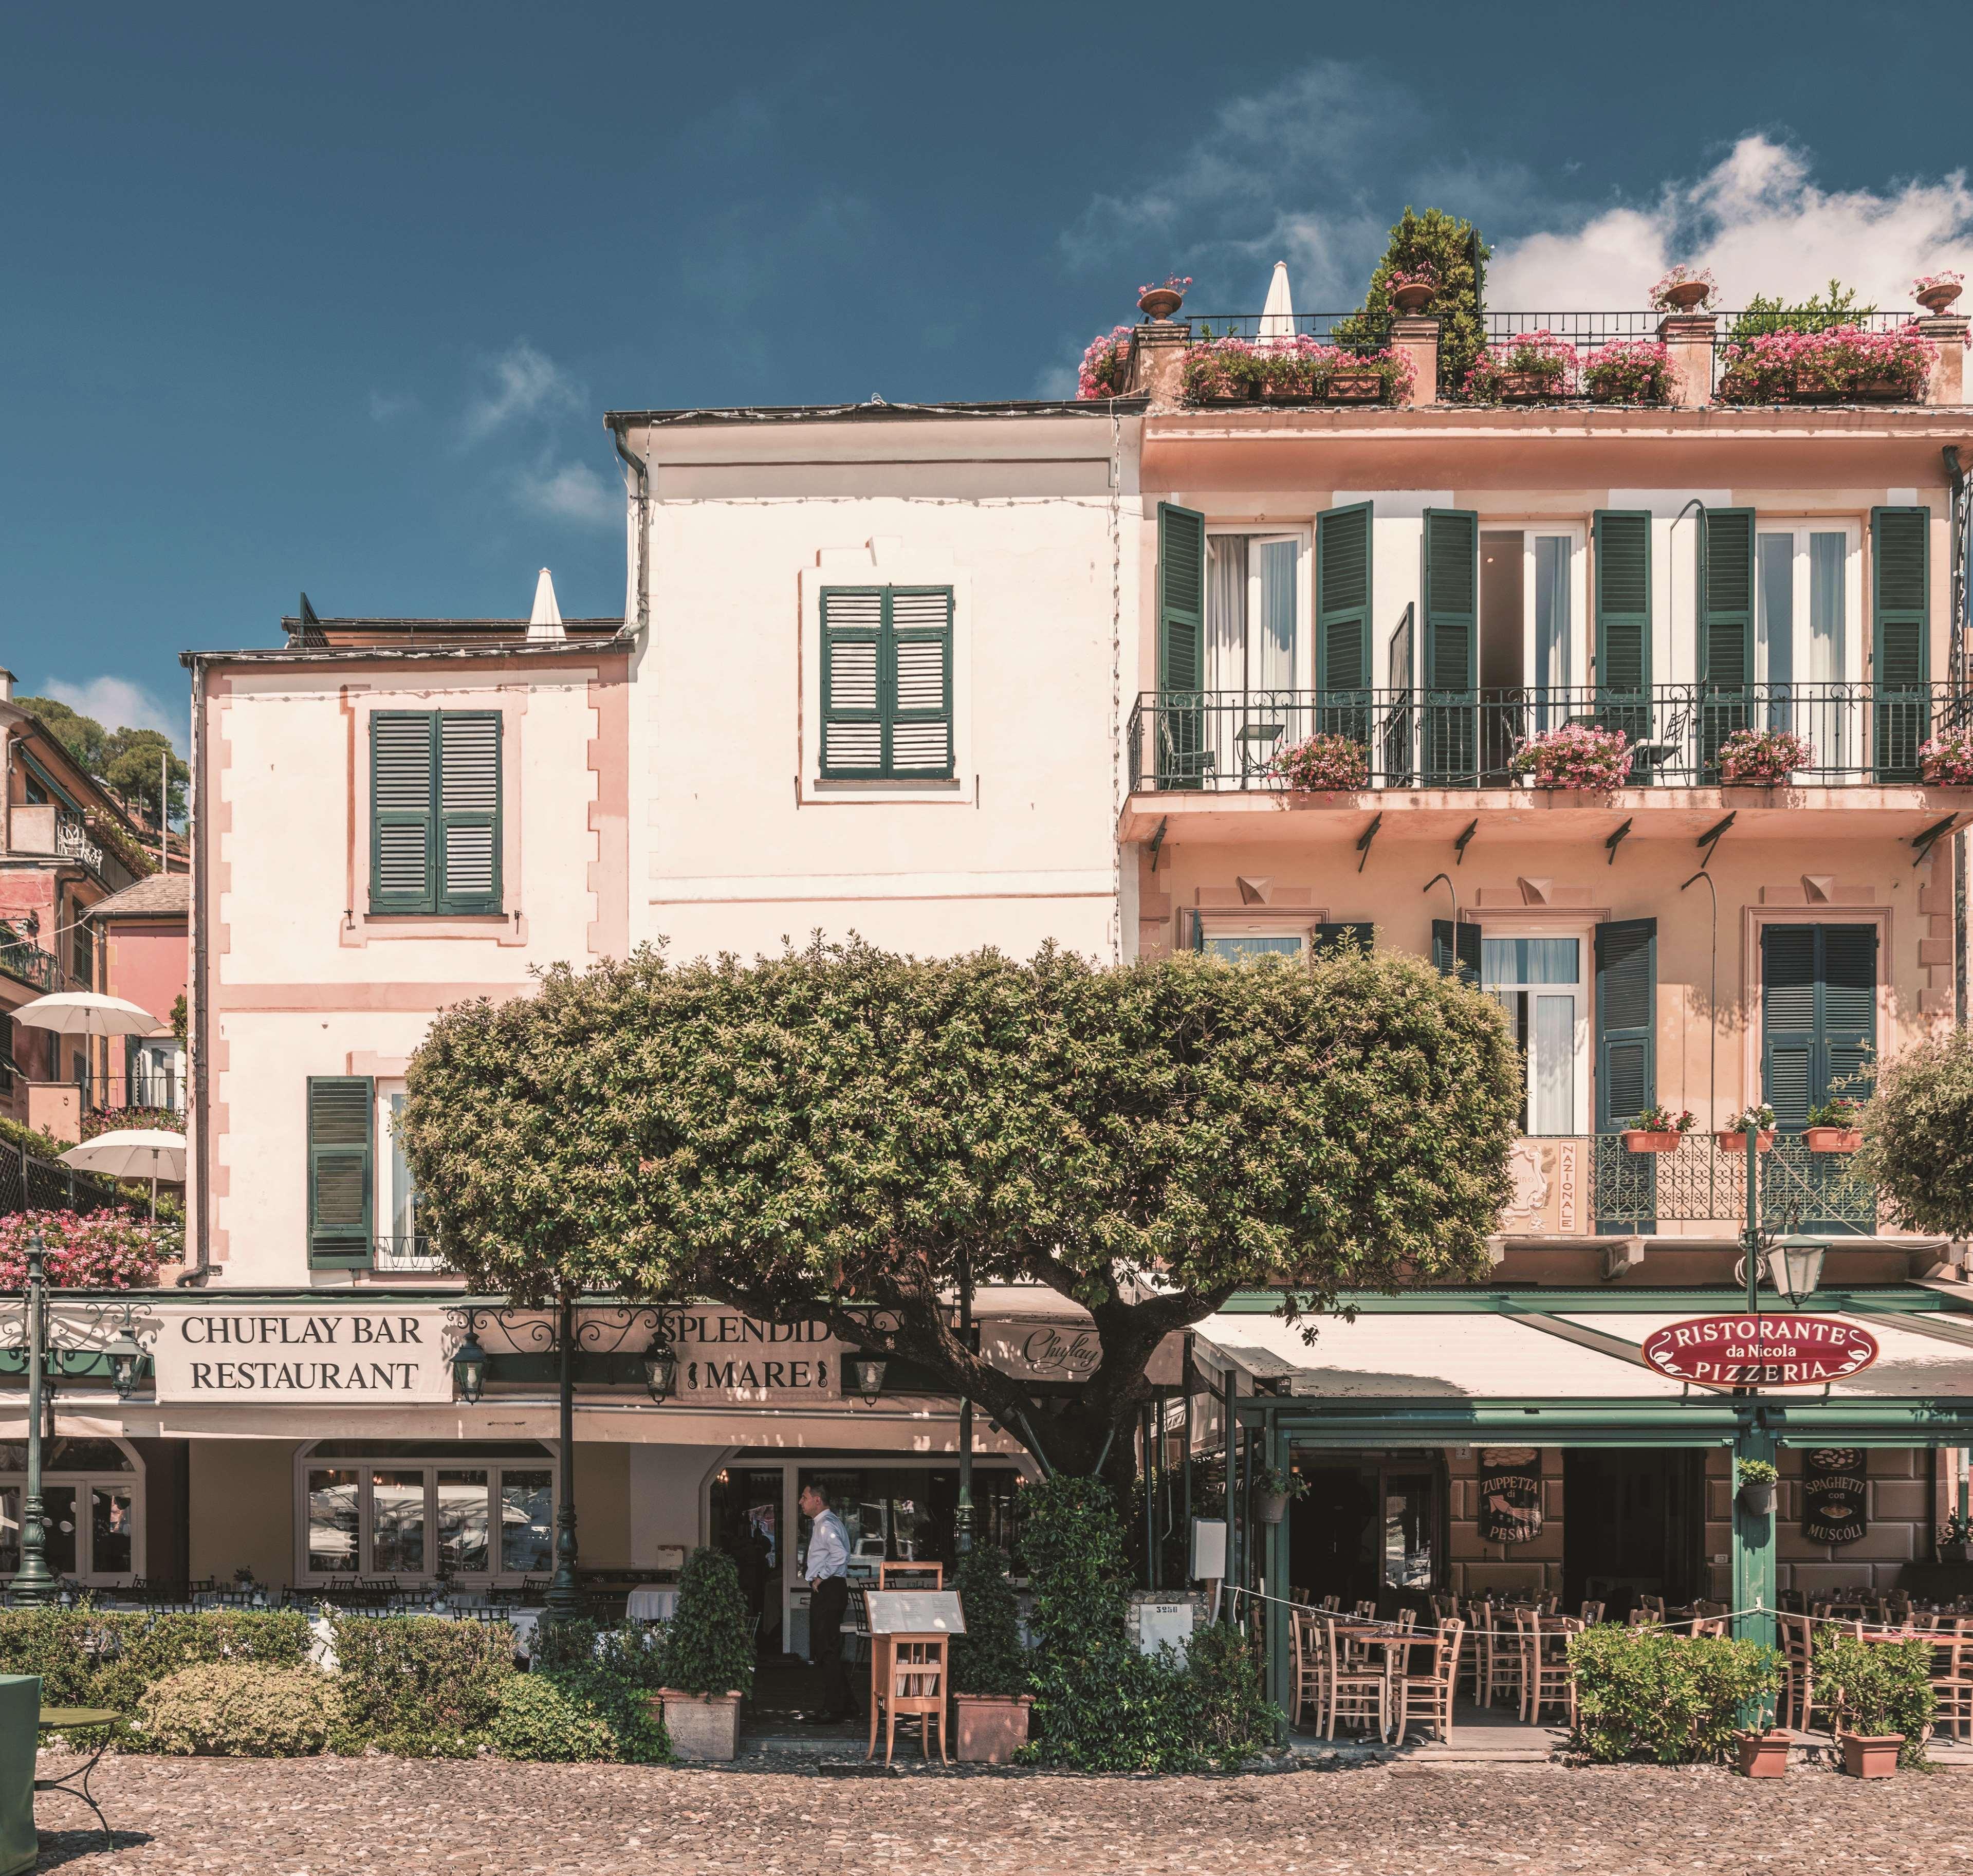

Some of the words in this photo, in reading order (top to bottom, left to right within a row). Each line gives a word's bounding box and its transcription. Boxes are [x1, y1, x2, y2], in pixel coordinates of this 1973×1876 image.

[1561, 1146, 1573, 1227] NAZIONALE
[181, 1316, 341, 1344] CHUFLAY
[351, 1317, 423, 1344] BAR
[661, 1315, 846, 1342] SPLENDID
[1674, 1321, 1847, 1348] RISTORANTE
[1022, 1328, 1101, 1375] Chuflay
[1726, 1344, 1744, 1357] da
[1748, 1344, 1796, 1357] Nicola
[189, 1362, 419, 1389] RESTAURANT
[704, 1360, 812, 1388] MARE
[1694, 1360, 1829, 1382] PIZZERIA
[1481, 1476, 1537, 1495] ZUPPETTA
[1805, 1477, 1866, 1495] SPAGHETTI
[1489, 1525, 1531, 1542] PESCE
